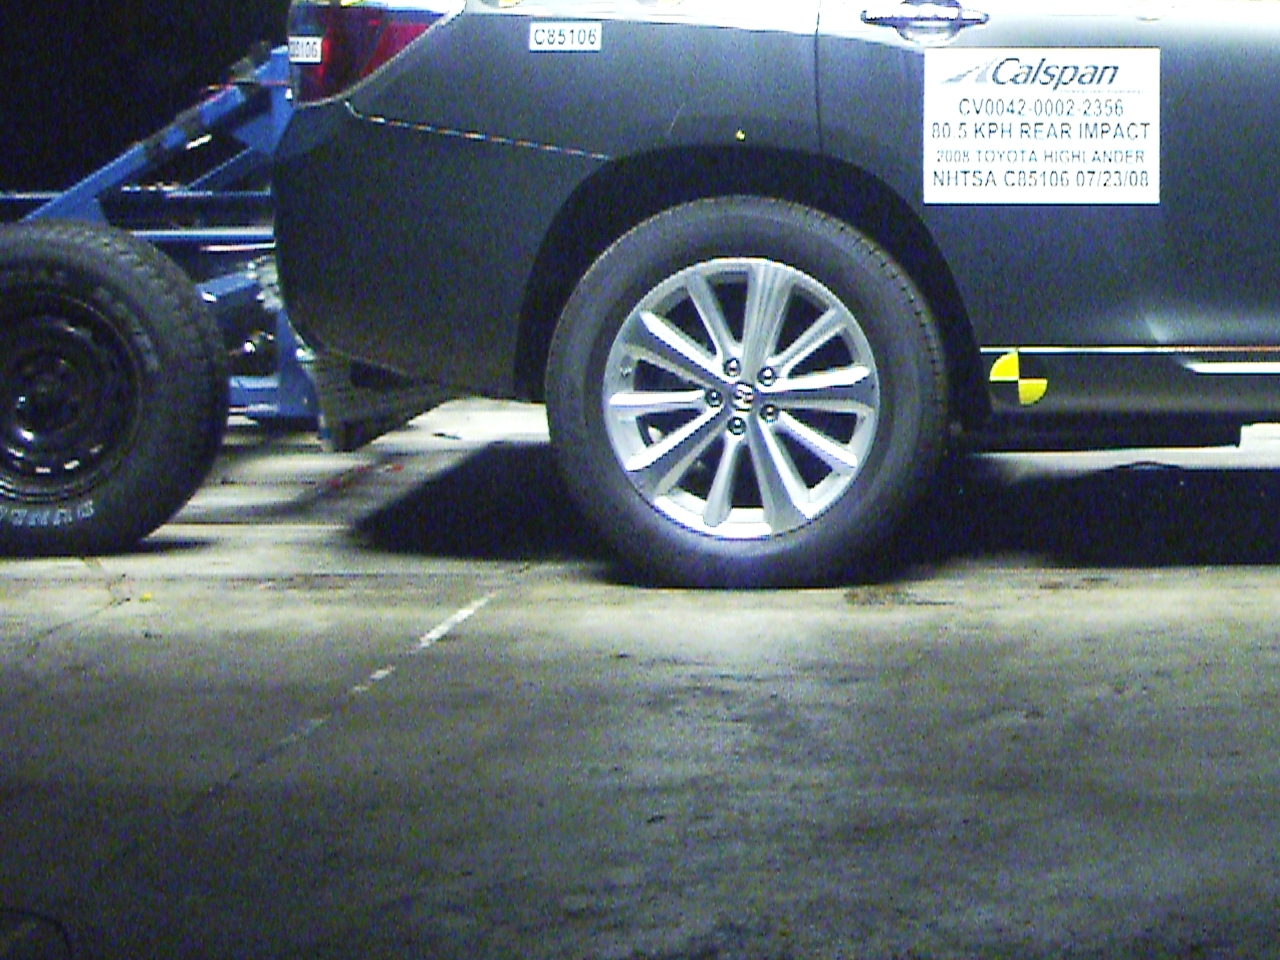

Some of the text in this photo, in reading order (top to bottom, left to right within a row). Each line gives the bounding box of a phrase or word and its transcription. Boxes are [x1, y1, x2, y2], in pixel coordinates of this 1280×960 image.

[534, 26, 597, 45] C85106
[991, 57, 1120, 91] Calspan
[958, 98, 1124, 117] CV0042-0002-2356
[931, 122, 1151, 140] 80.5 KPH REAR IMPACT
[936, 149, 1146, 164] 2008 TOYOTA HIGHLANDER
[932, 170, 1150, 188] NHTSA C85106 07/23/08
